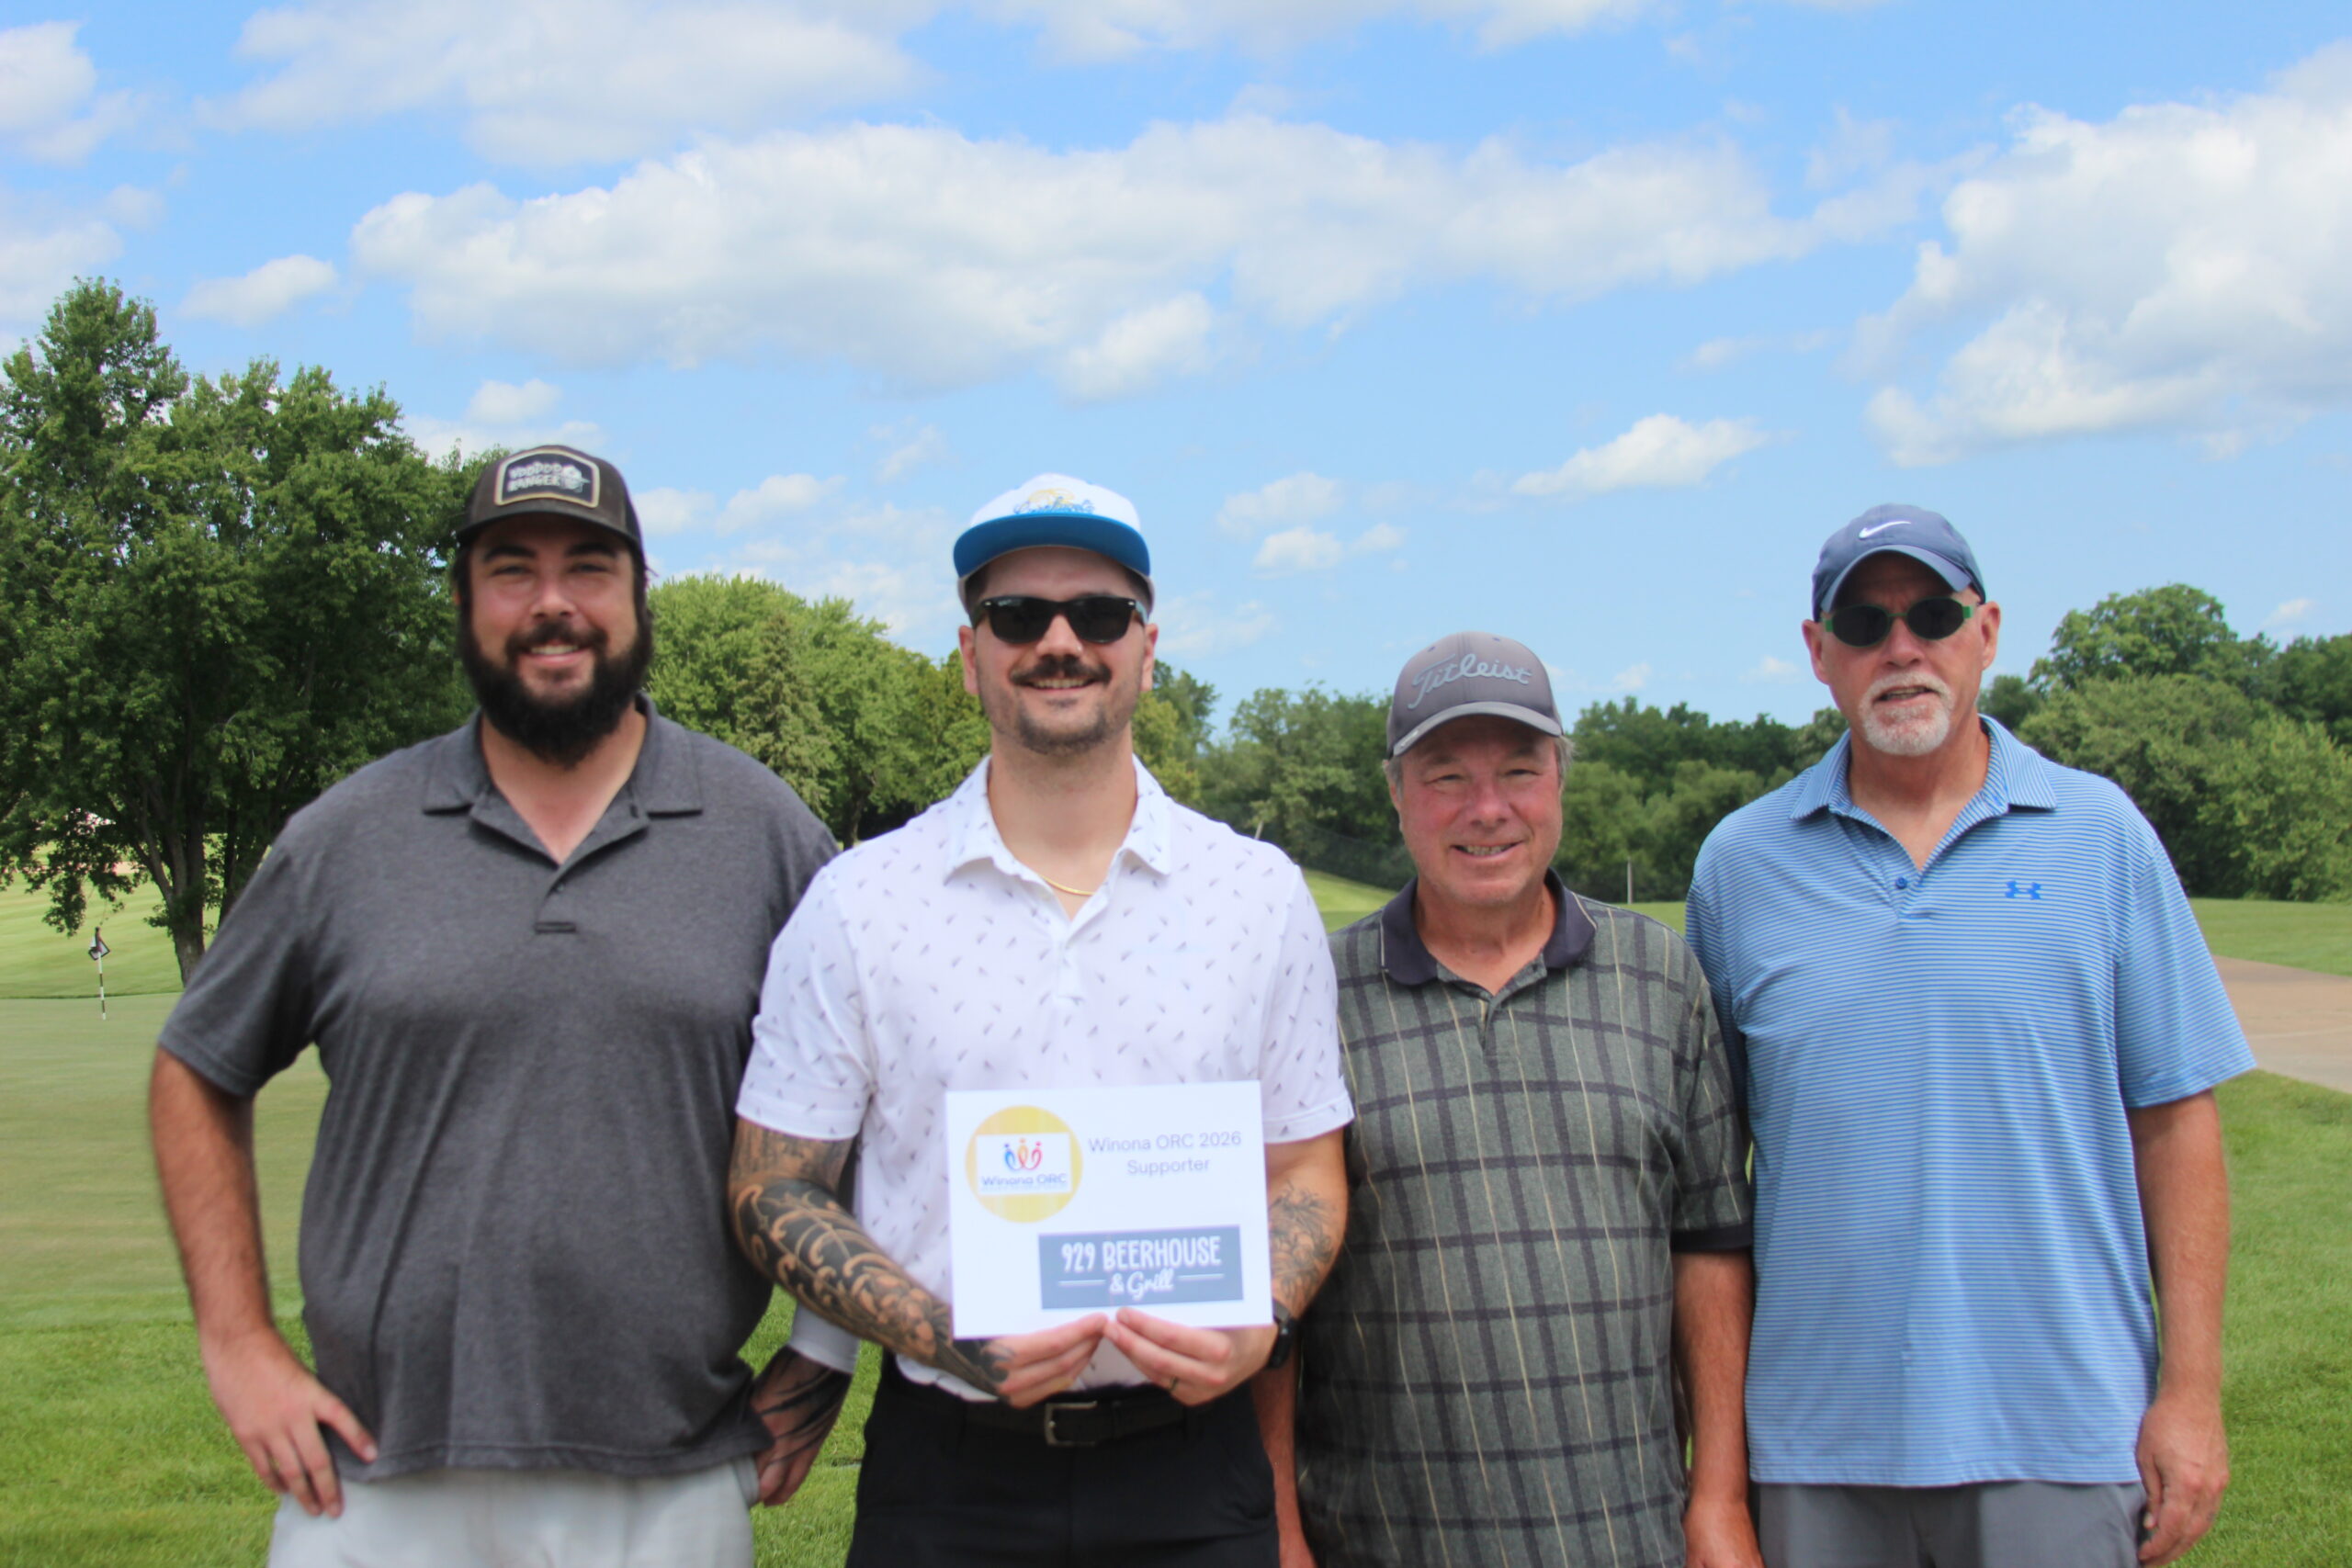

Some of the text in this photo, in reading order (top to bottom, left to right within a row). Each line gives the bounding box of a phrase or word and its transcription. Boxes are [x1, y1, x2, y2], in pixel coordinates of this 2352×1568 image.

[1408, 653, 1532, 709] Titleist
[1088, 1131, 1242, 1152] Winona ORC 2026
[981, 1172, 1067, 1186] Winona ORC
[1127, 1157, 1211, 1177] Supporter
[1061, 1235, 1222, 1272] 929 BEERHOUSE
[1109, 1268, 1175, 1301] & Grill
